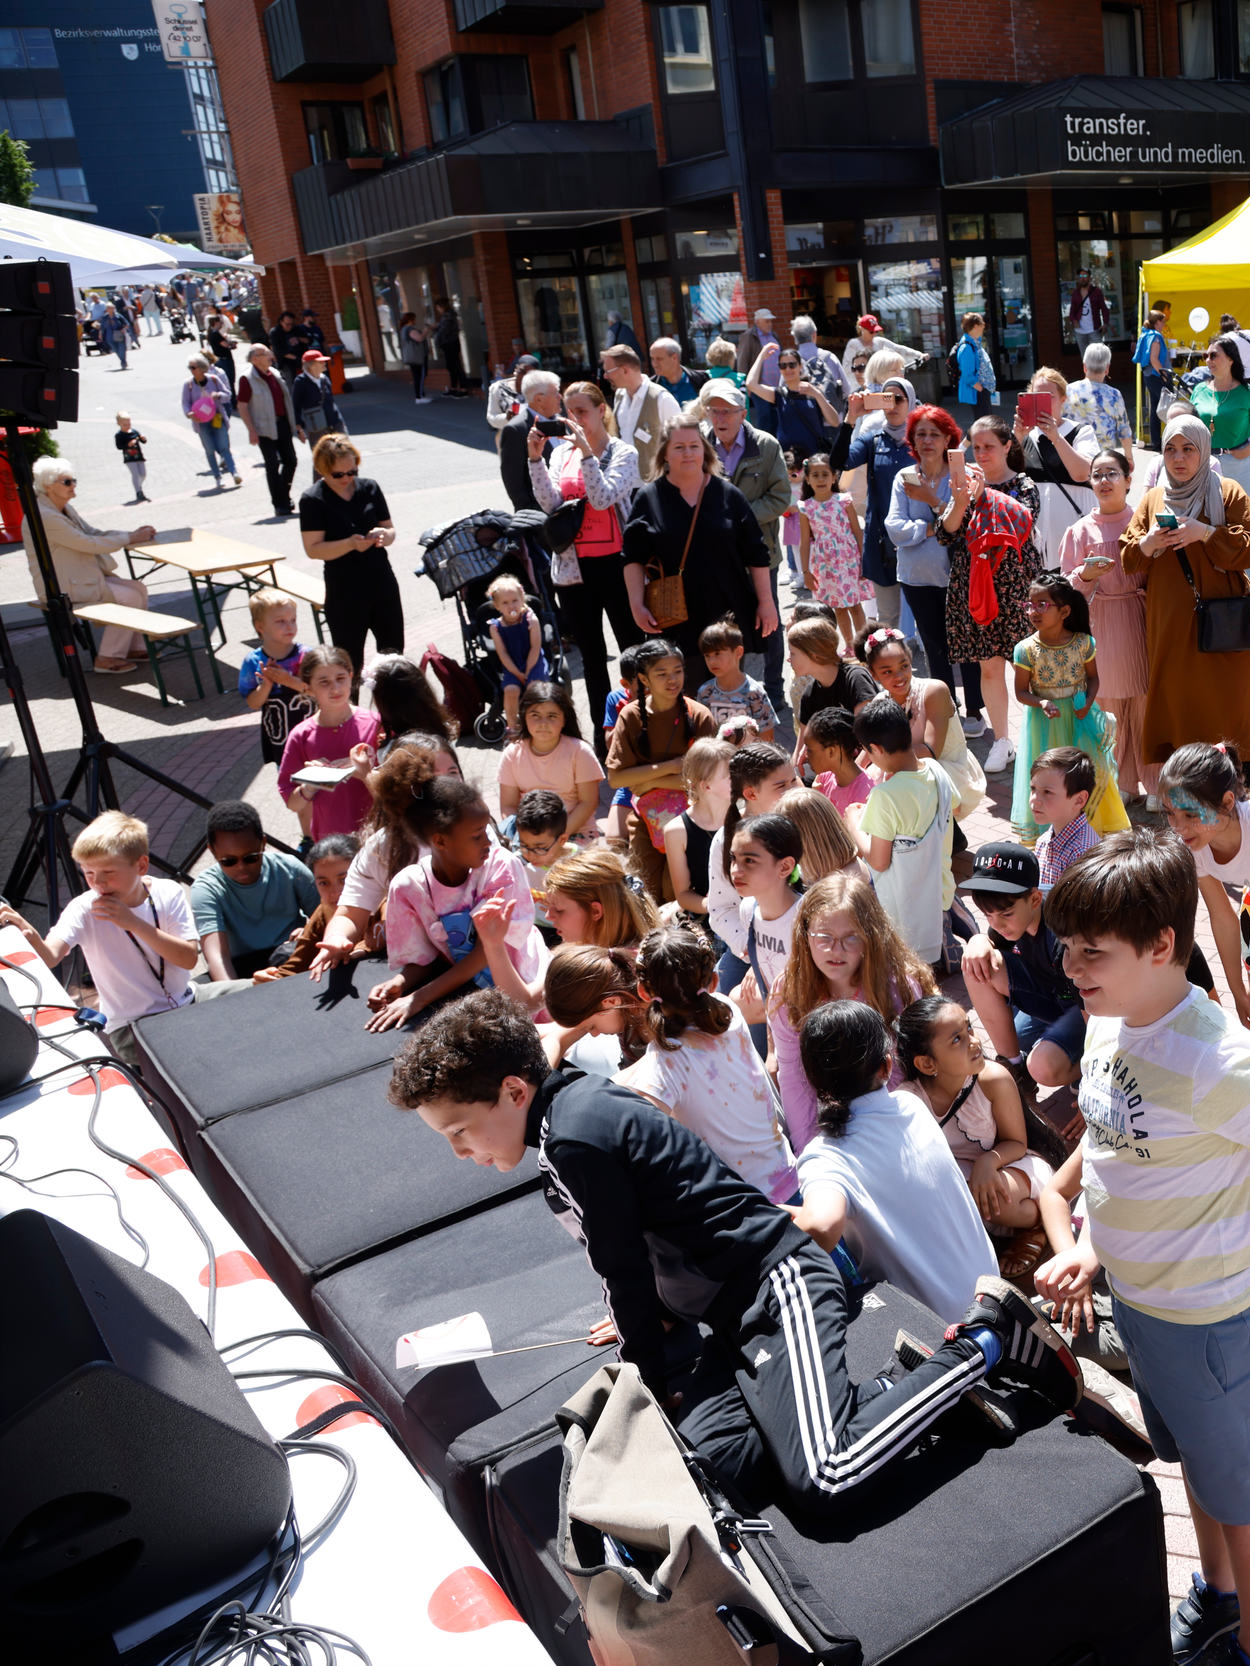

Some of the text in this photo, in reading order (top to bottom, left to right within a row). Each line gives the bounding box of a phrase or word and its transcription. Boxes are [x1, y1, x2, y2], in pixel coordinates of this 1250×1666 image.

[54, 28, 160, 39] Bezirksverwaltungsste
[144, 43, 161, 52] Hör
[1064, 113, 1150, 136] transfer.
[1067, 140, 1246, 164] bücher und medien.
[198, 197, 213, 242] HAARTOPIA
[974, 856, 1023, 871] JORDAN
[755, 931, 786, 955] LIVIA
